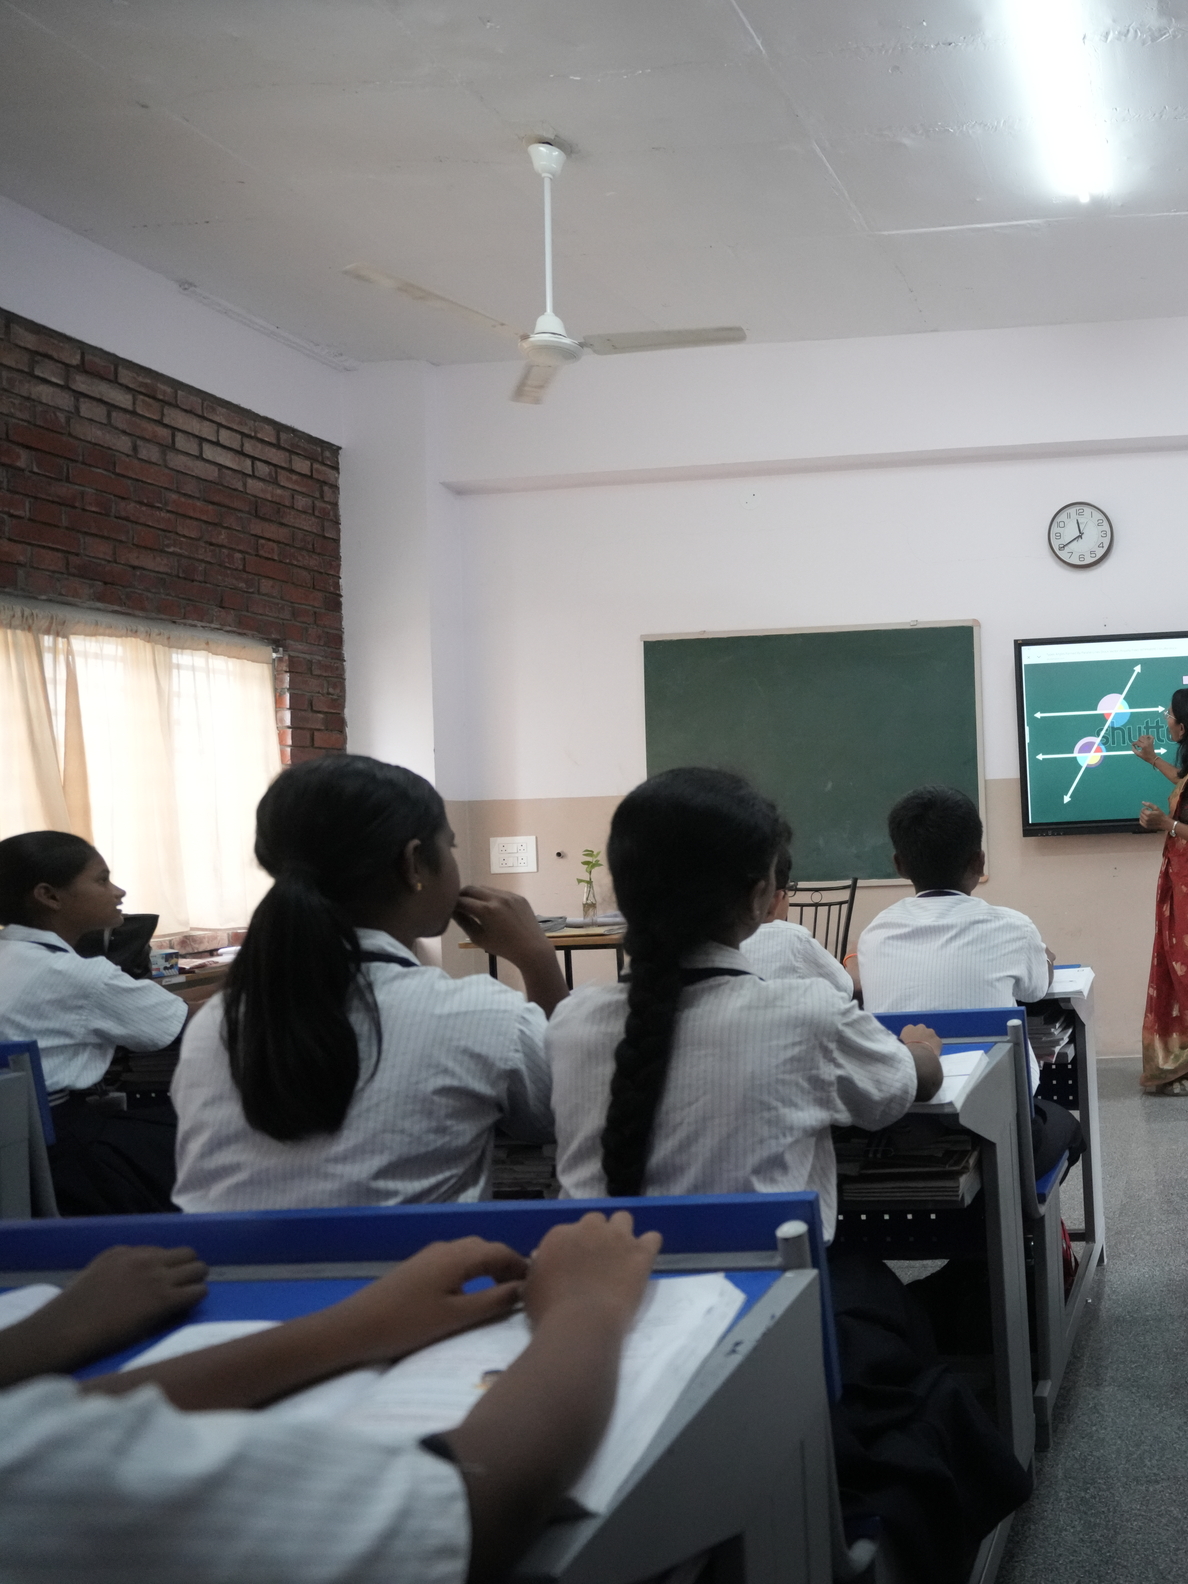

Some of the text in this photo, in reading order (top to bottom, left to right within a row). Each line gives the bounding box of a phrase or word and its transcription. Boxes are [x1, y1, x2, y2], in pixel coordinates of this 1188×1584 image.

[1075, 508, 1085, 516] 12
[1055, 532, 1061, 540] 9
[1101, 530, 1107, 538] 3
[1058, 543, 1065, 551] 8
[1067, 551, 1074, 559] 7
[1079, 554, 1085, 562] 6
